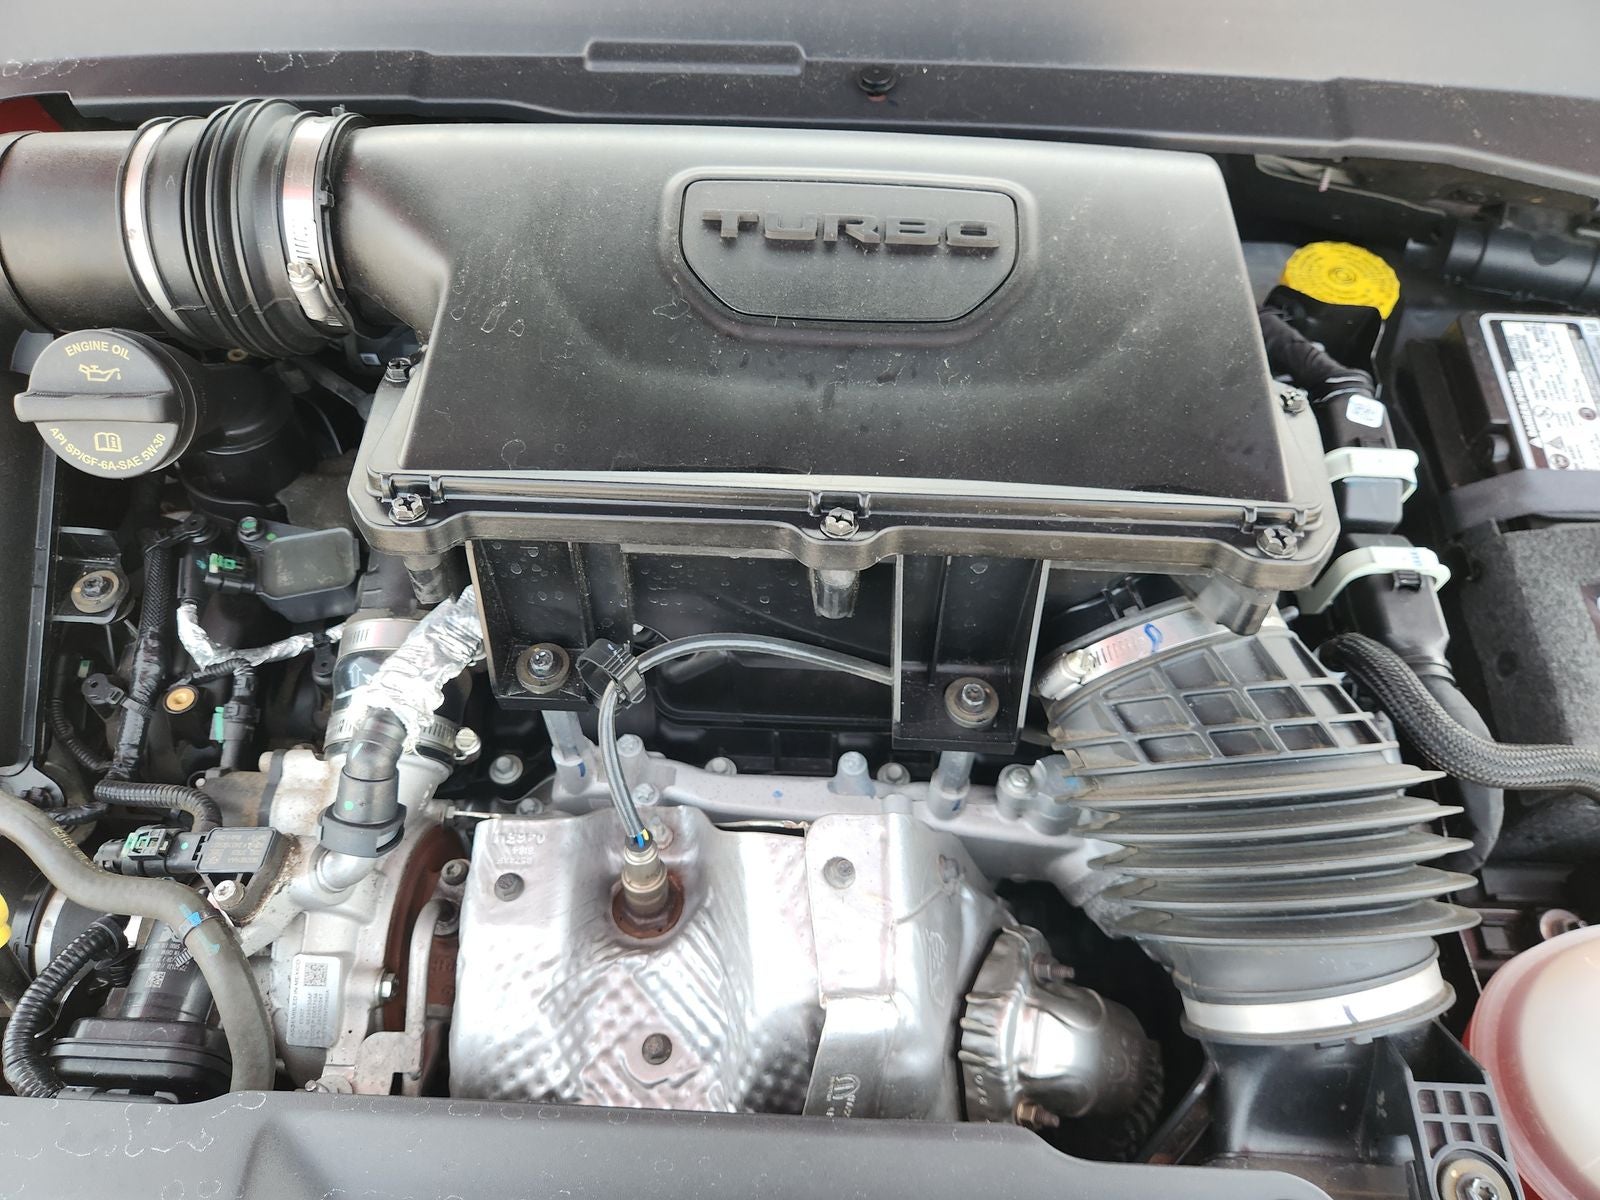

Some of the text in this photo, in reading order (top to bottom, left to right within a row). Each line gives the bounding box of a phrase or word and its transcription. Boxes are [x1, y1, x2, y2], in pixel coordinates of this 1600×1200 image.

[701, 208, 1000, 248] TURBO
[64, 341, 131, 361] ENGINE OIL
[49, 427, 68, 446] API
[141, 433, 166, 461] 5W-30
